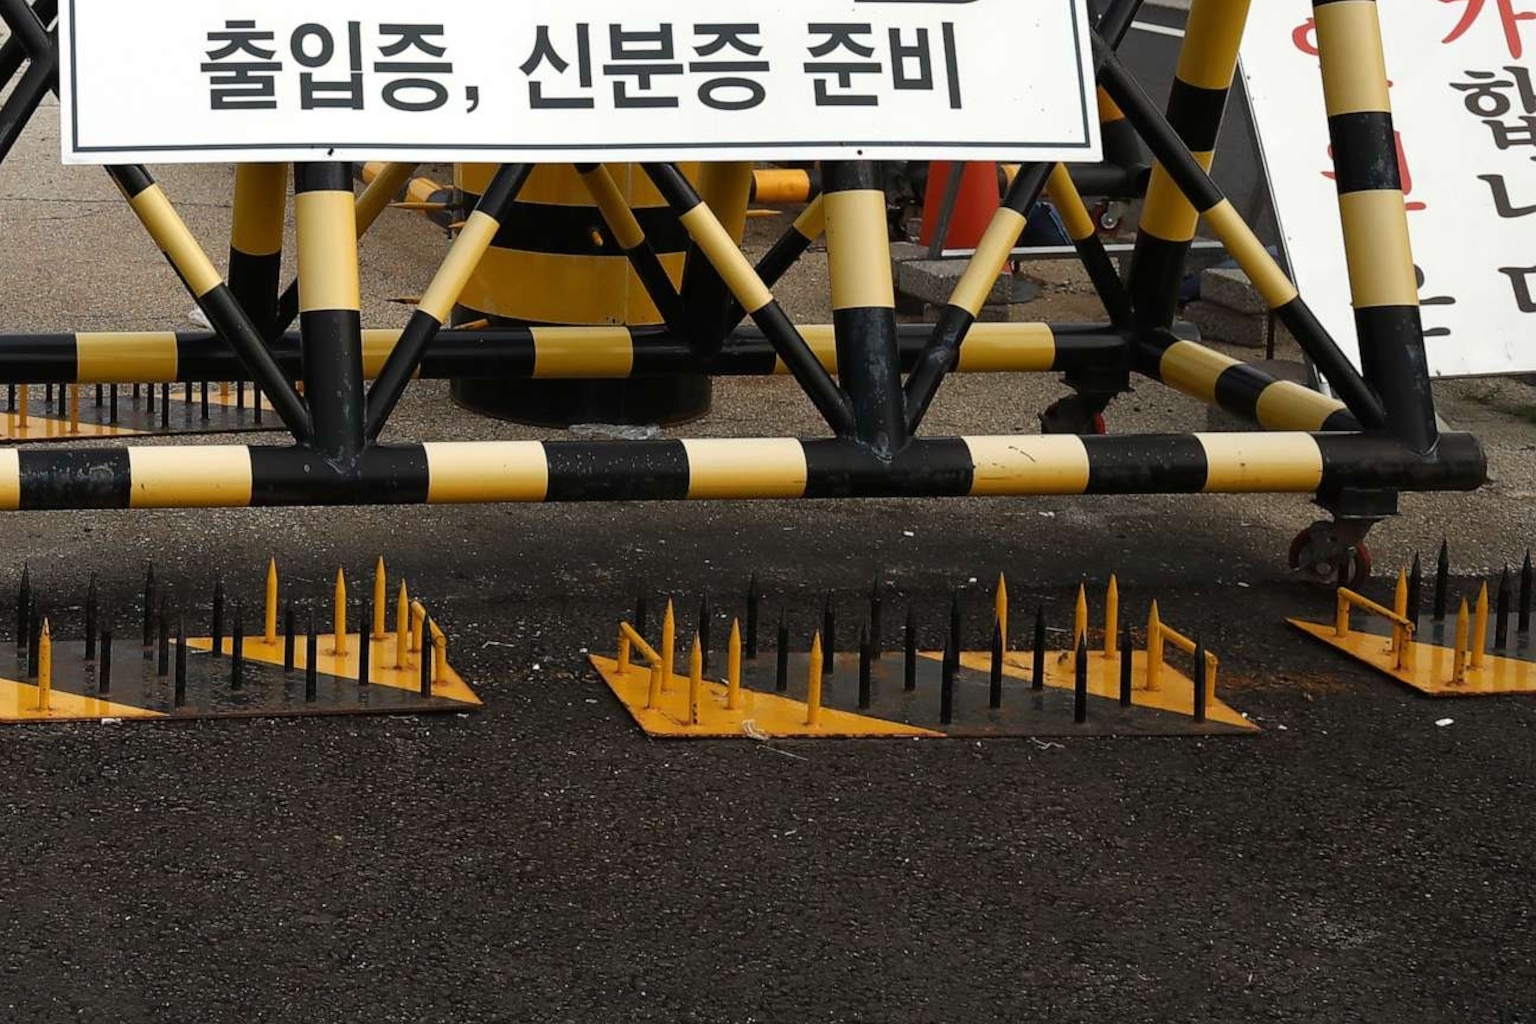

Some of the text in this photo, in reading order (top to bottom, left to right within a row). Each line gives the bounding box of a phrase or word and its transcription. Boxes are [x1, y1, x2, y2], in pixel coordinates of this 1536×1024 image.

[201, 21, 961, 112] 출입증, 신분증 준비
